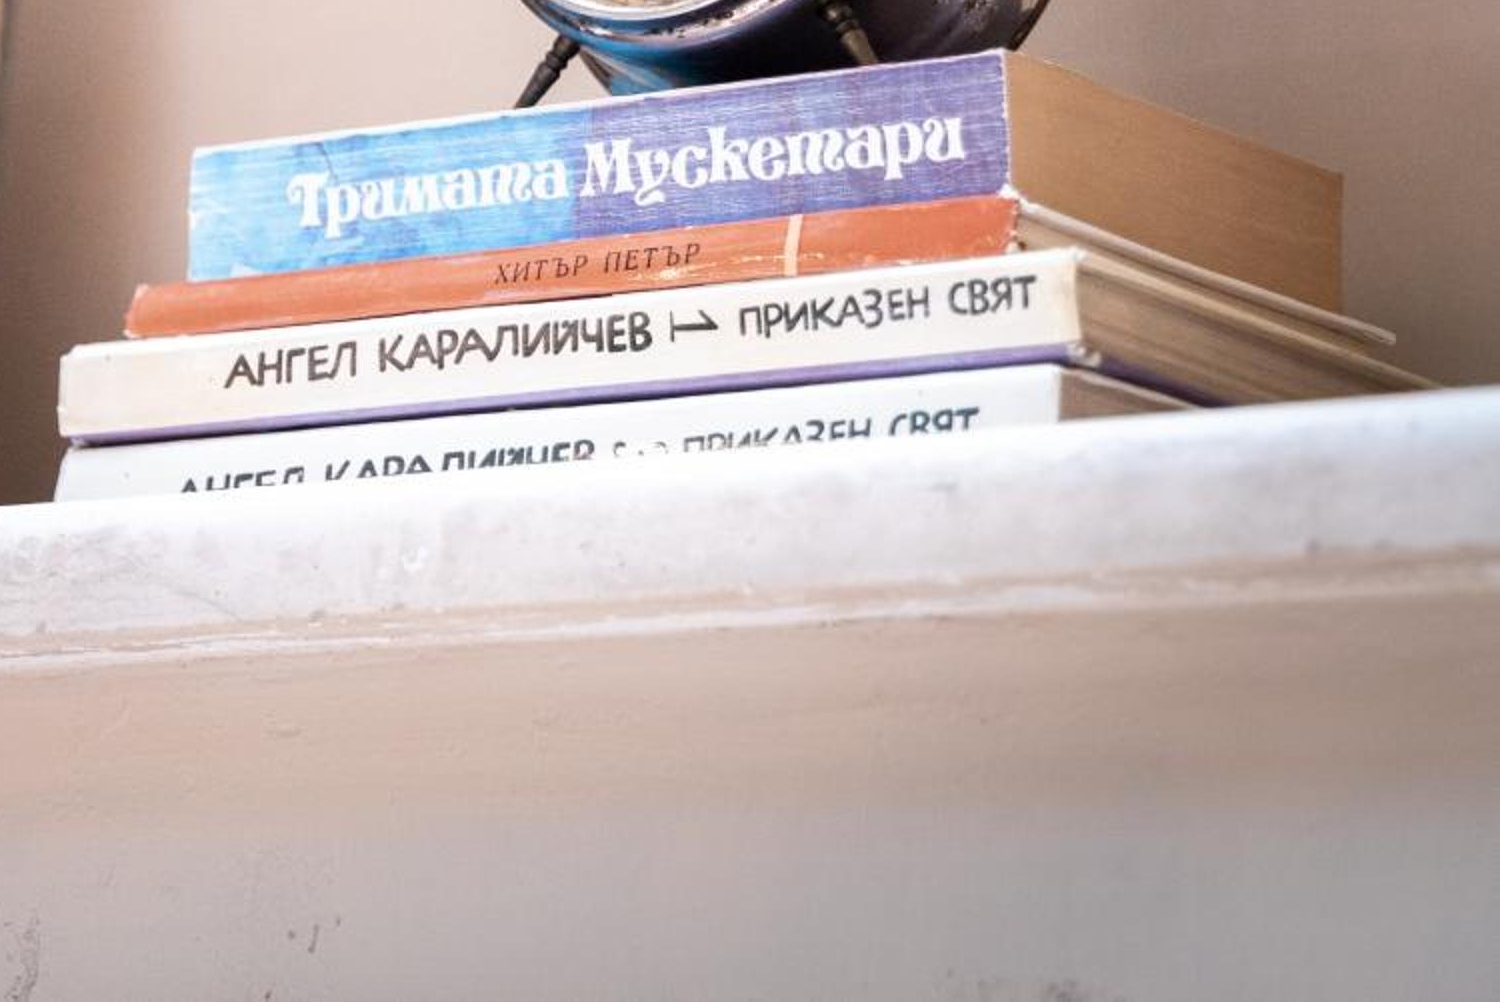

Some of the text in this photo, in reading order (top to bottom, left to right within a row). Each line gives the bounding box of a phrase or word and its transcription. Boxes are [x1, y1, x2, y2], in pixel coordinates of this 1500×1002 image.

[288, 116, 966, 236] Тримата Мускетари
[494, 242, 701, 287] ХИТЪР ПЕТЪР
[223, 340, 357, 389] АНГЕЛ
[378, 311, 653, 372] КАРАЛИЙЧЕВ
[739, 286, 931, 339] ПРИКАЗЕН
[947, 274, 1038, 317] СВЯТ
